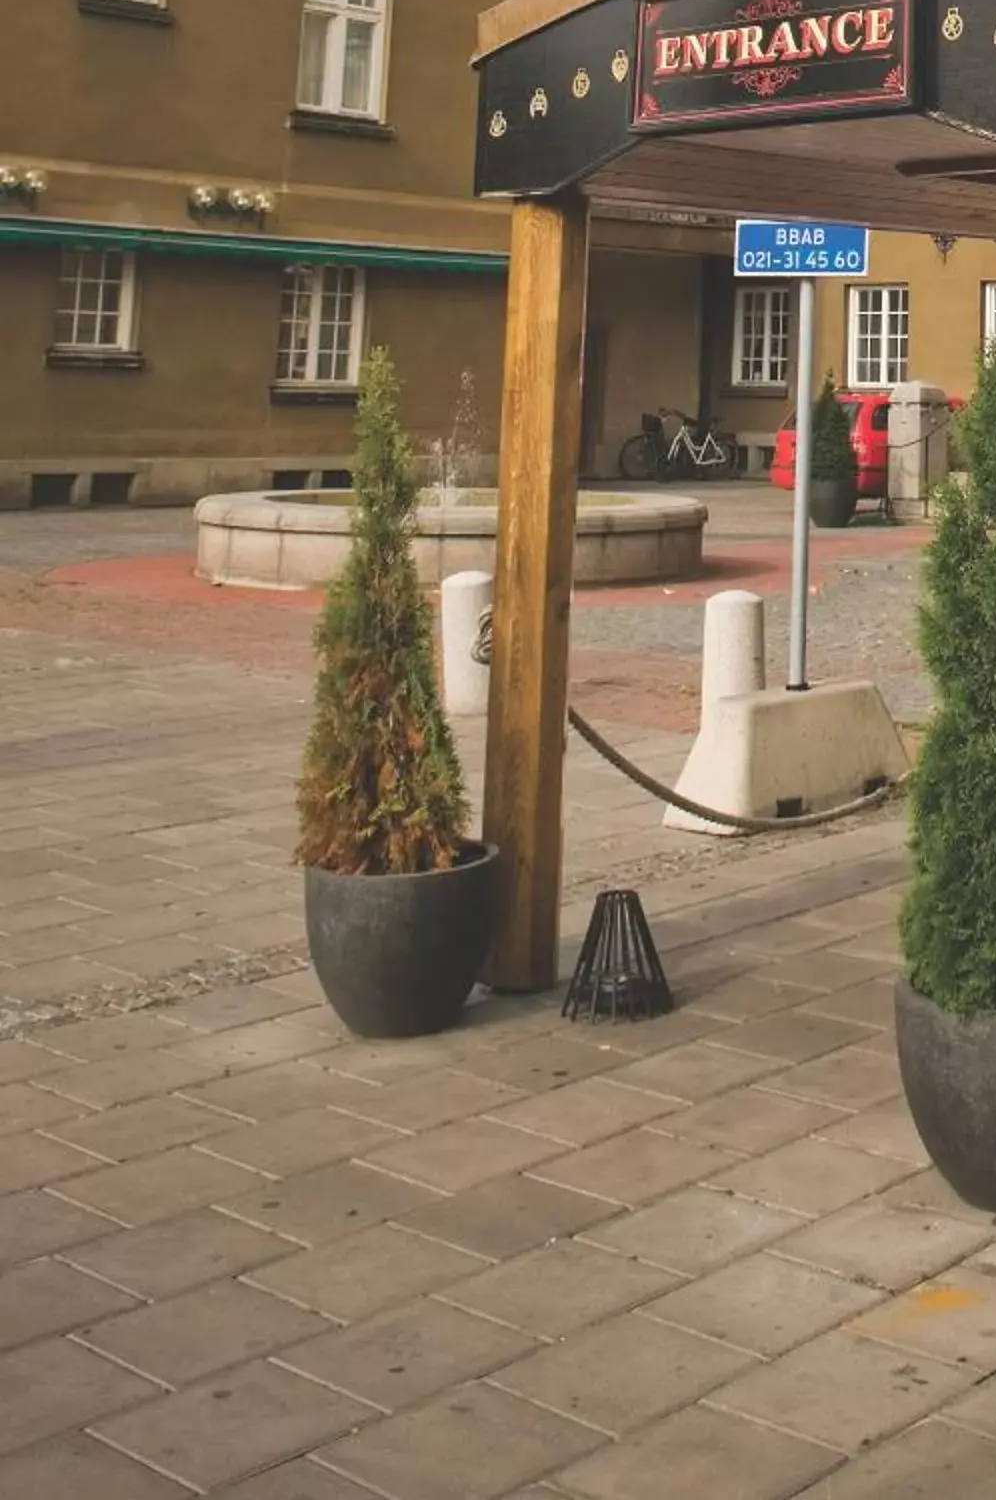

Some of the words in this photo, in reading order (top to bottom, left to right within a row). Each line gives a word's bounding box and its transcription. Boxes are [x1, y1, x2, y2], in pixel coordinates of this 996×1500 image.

[655, 7, 894, 76] ENTRANCE
[776, 228, 825, 245] BBAB
[743, 251, 800, 268] 021-31
[806, 251, 828, 268] 45
[834, 251, 860, 268] 60
